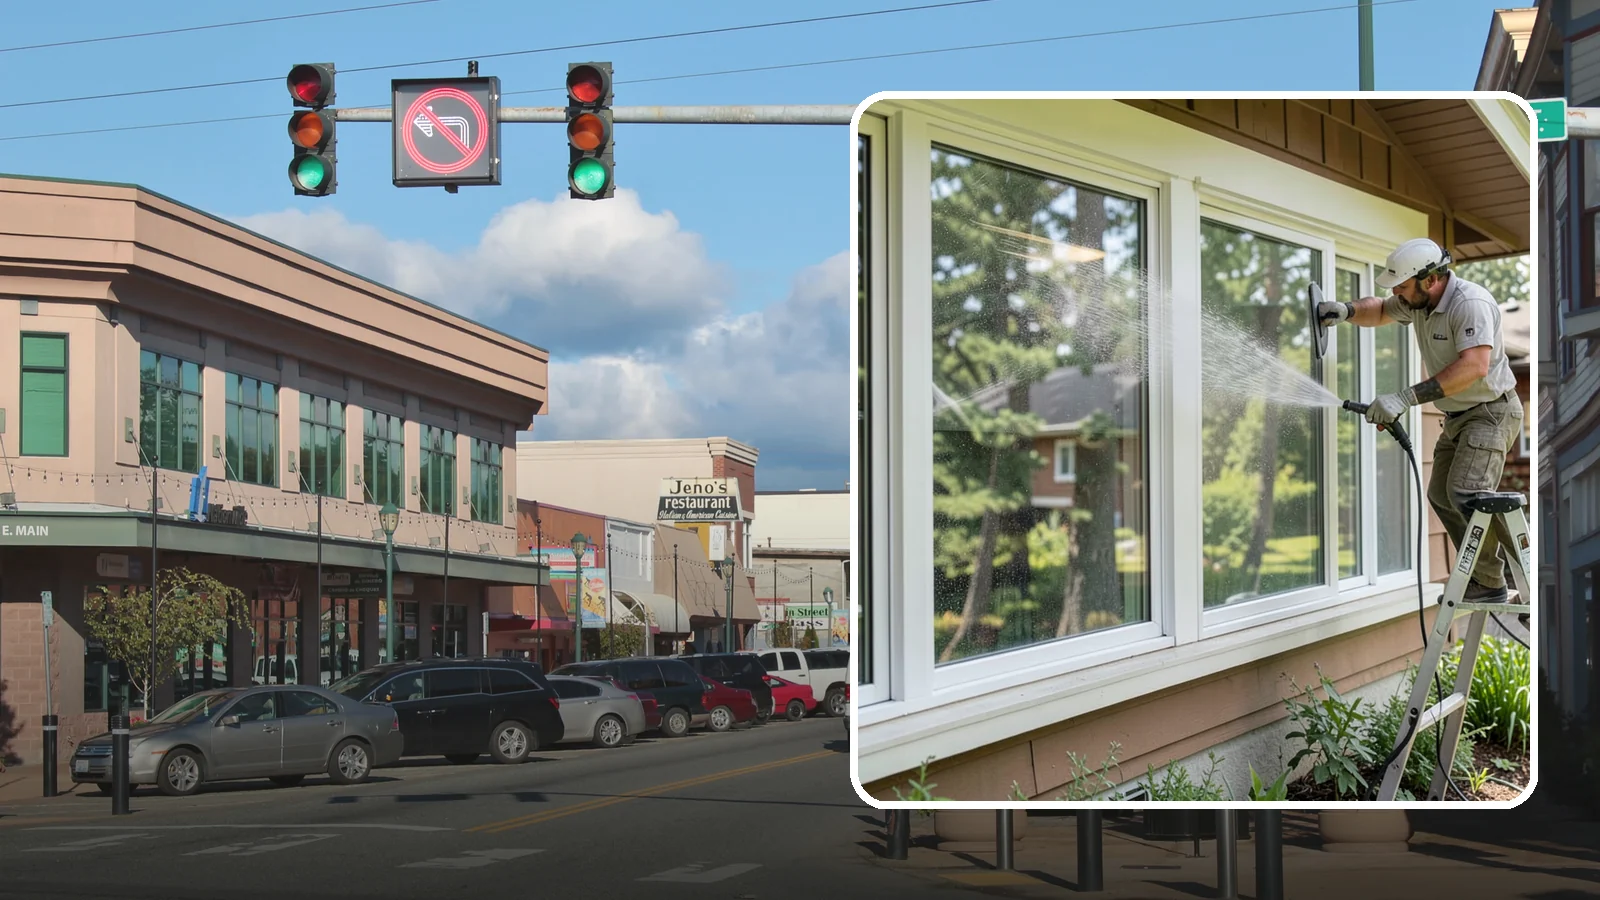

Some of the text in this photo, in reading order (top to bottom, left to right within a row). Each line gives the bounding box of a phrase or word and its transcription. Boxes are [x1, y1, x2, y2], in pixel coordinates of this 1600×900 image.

[670, 480, 727, 494] Jeno's
[665, 497, 731, 509] restaurant
[658, 510, 681, 519] Italian
[686, 510, 714, 519] American
[715, 509, 738, 519] Cuisine
[2, 525, 49, 536] E. MAIN
[797, 608, 828, 617] Street
[791, 619, 823, 627] lass
